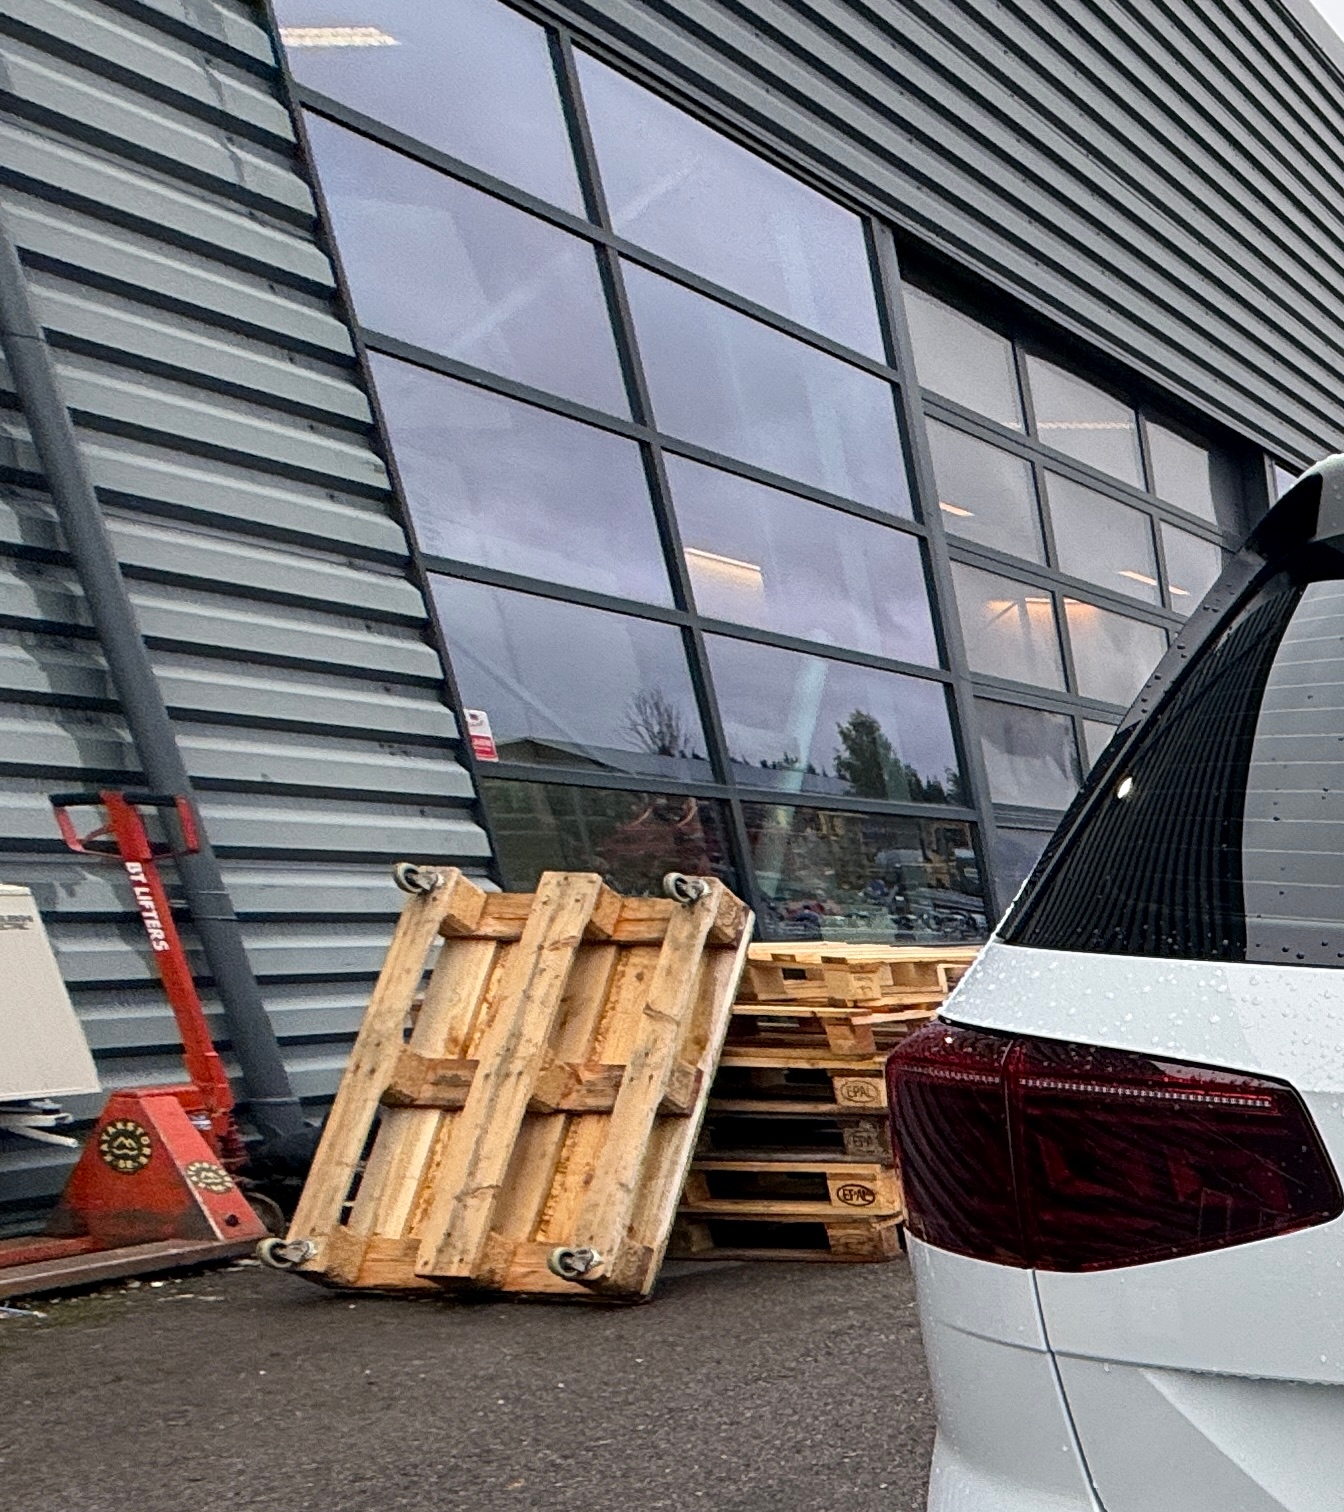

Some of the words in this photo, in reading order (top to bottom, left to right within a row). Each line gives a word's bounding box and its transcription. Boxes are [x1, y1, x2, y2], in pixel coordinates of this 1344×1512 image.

[125, 862, 148, 883] BT
[133, 886, 170, 951] LIFTERS
[846, 1085, 875, 1099] EPAL
